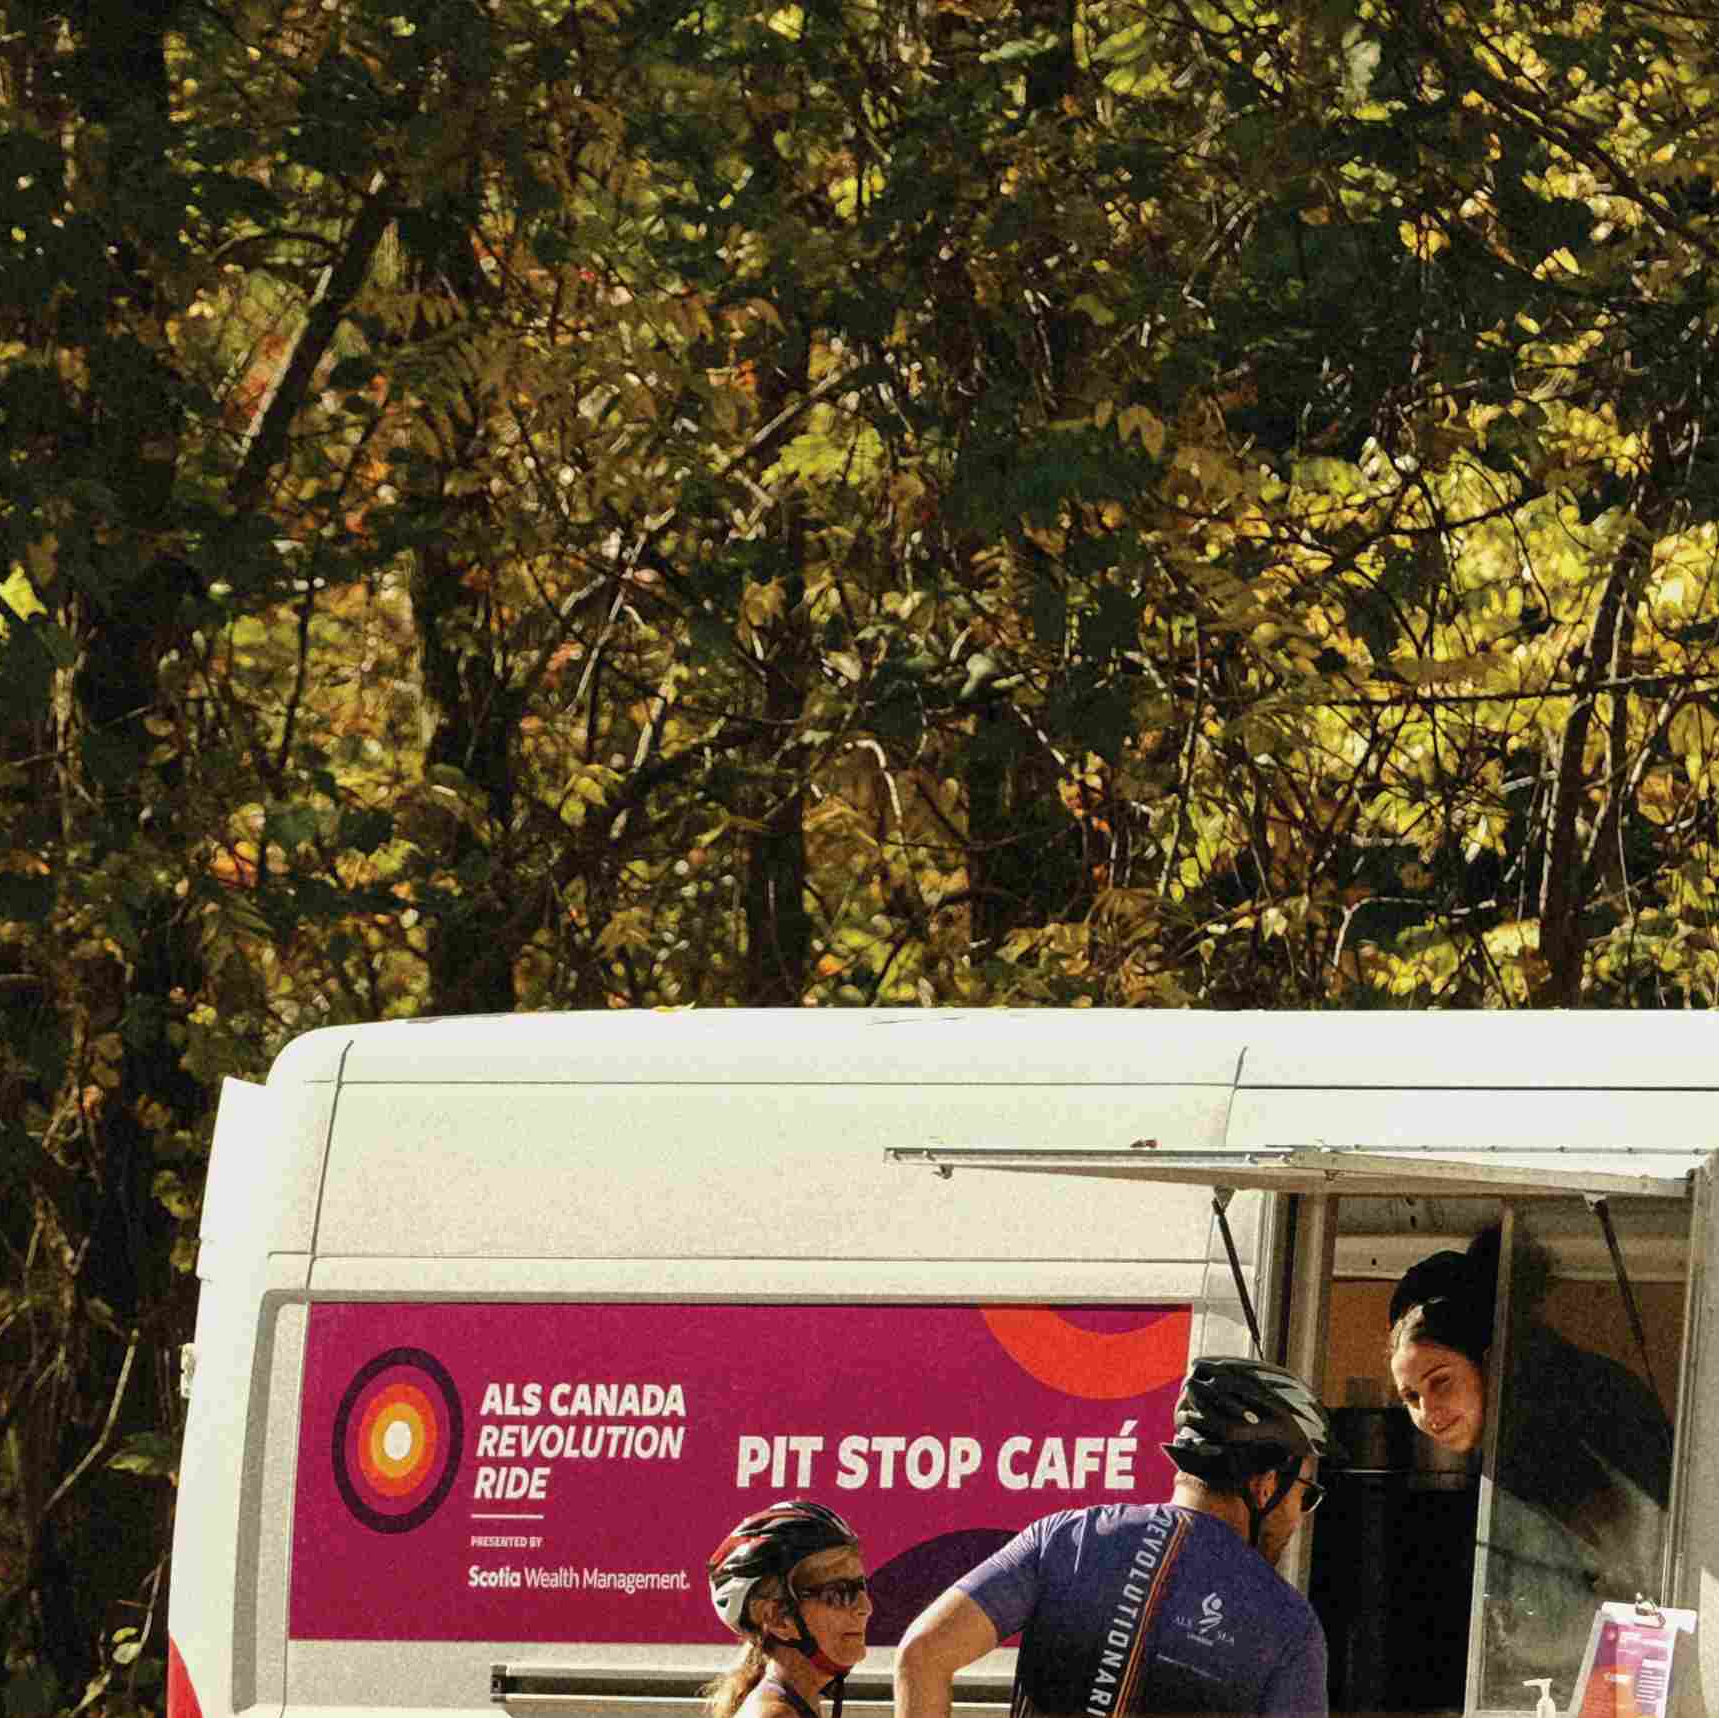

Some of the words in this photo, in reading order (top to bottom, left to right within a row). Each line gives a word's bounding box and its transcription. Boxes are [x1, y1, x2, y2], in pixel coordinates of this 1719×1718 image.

[480, 1383, 542, 1416] ALS
[550, 1383, 686, 1417] CANADA
[476, 1424, 685, 1460] REVOLUTION
[737, 1436, 825, 1489] PIT
[836, 1435, 982, 1490] STOP
[996, 1419, 1139, 1490] CAFÉ
[474, 1466, 551, 1500] RIDE
[470, 1535, 527, 1548] PRESENTED
[529, 1536, 543, 1548] BY
[468, 1565, 522, 1588] Scotia
[524, 1566, 580, 1589] Wealth
